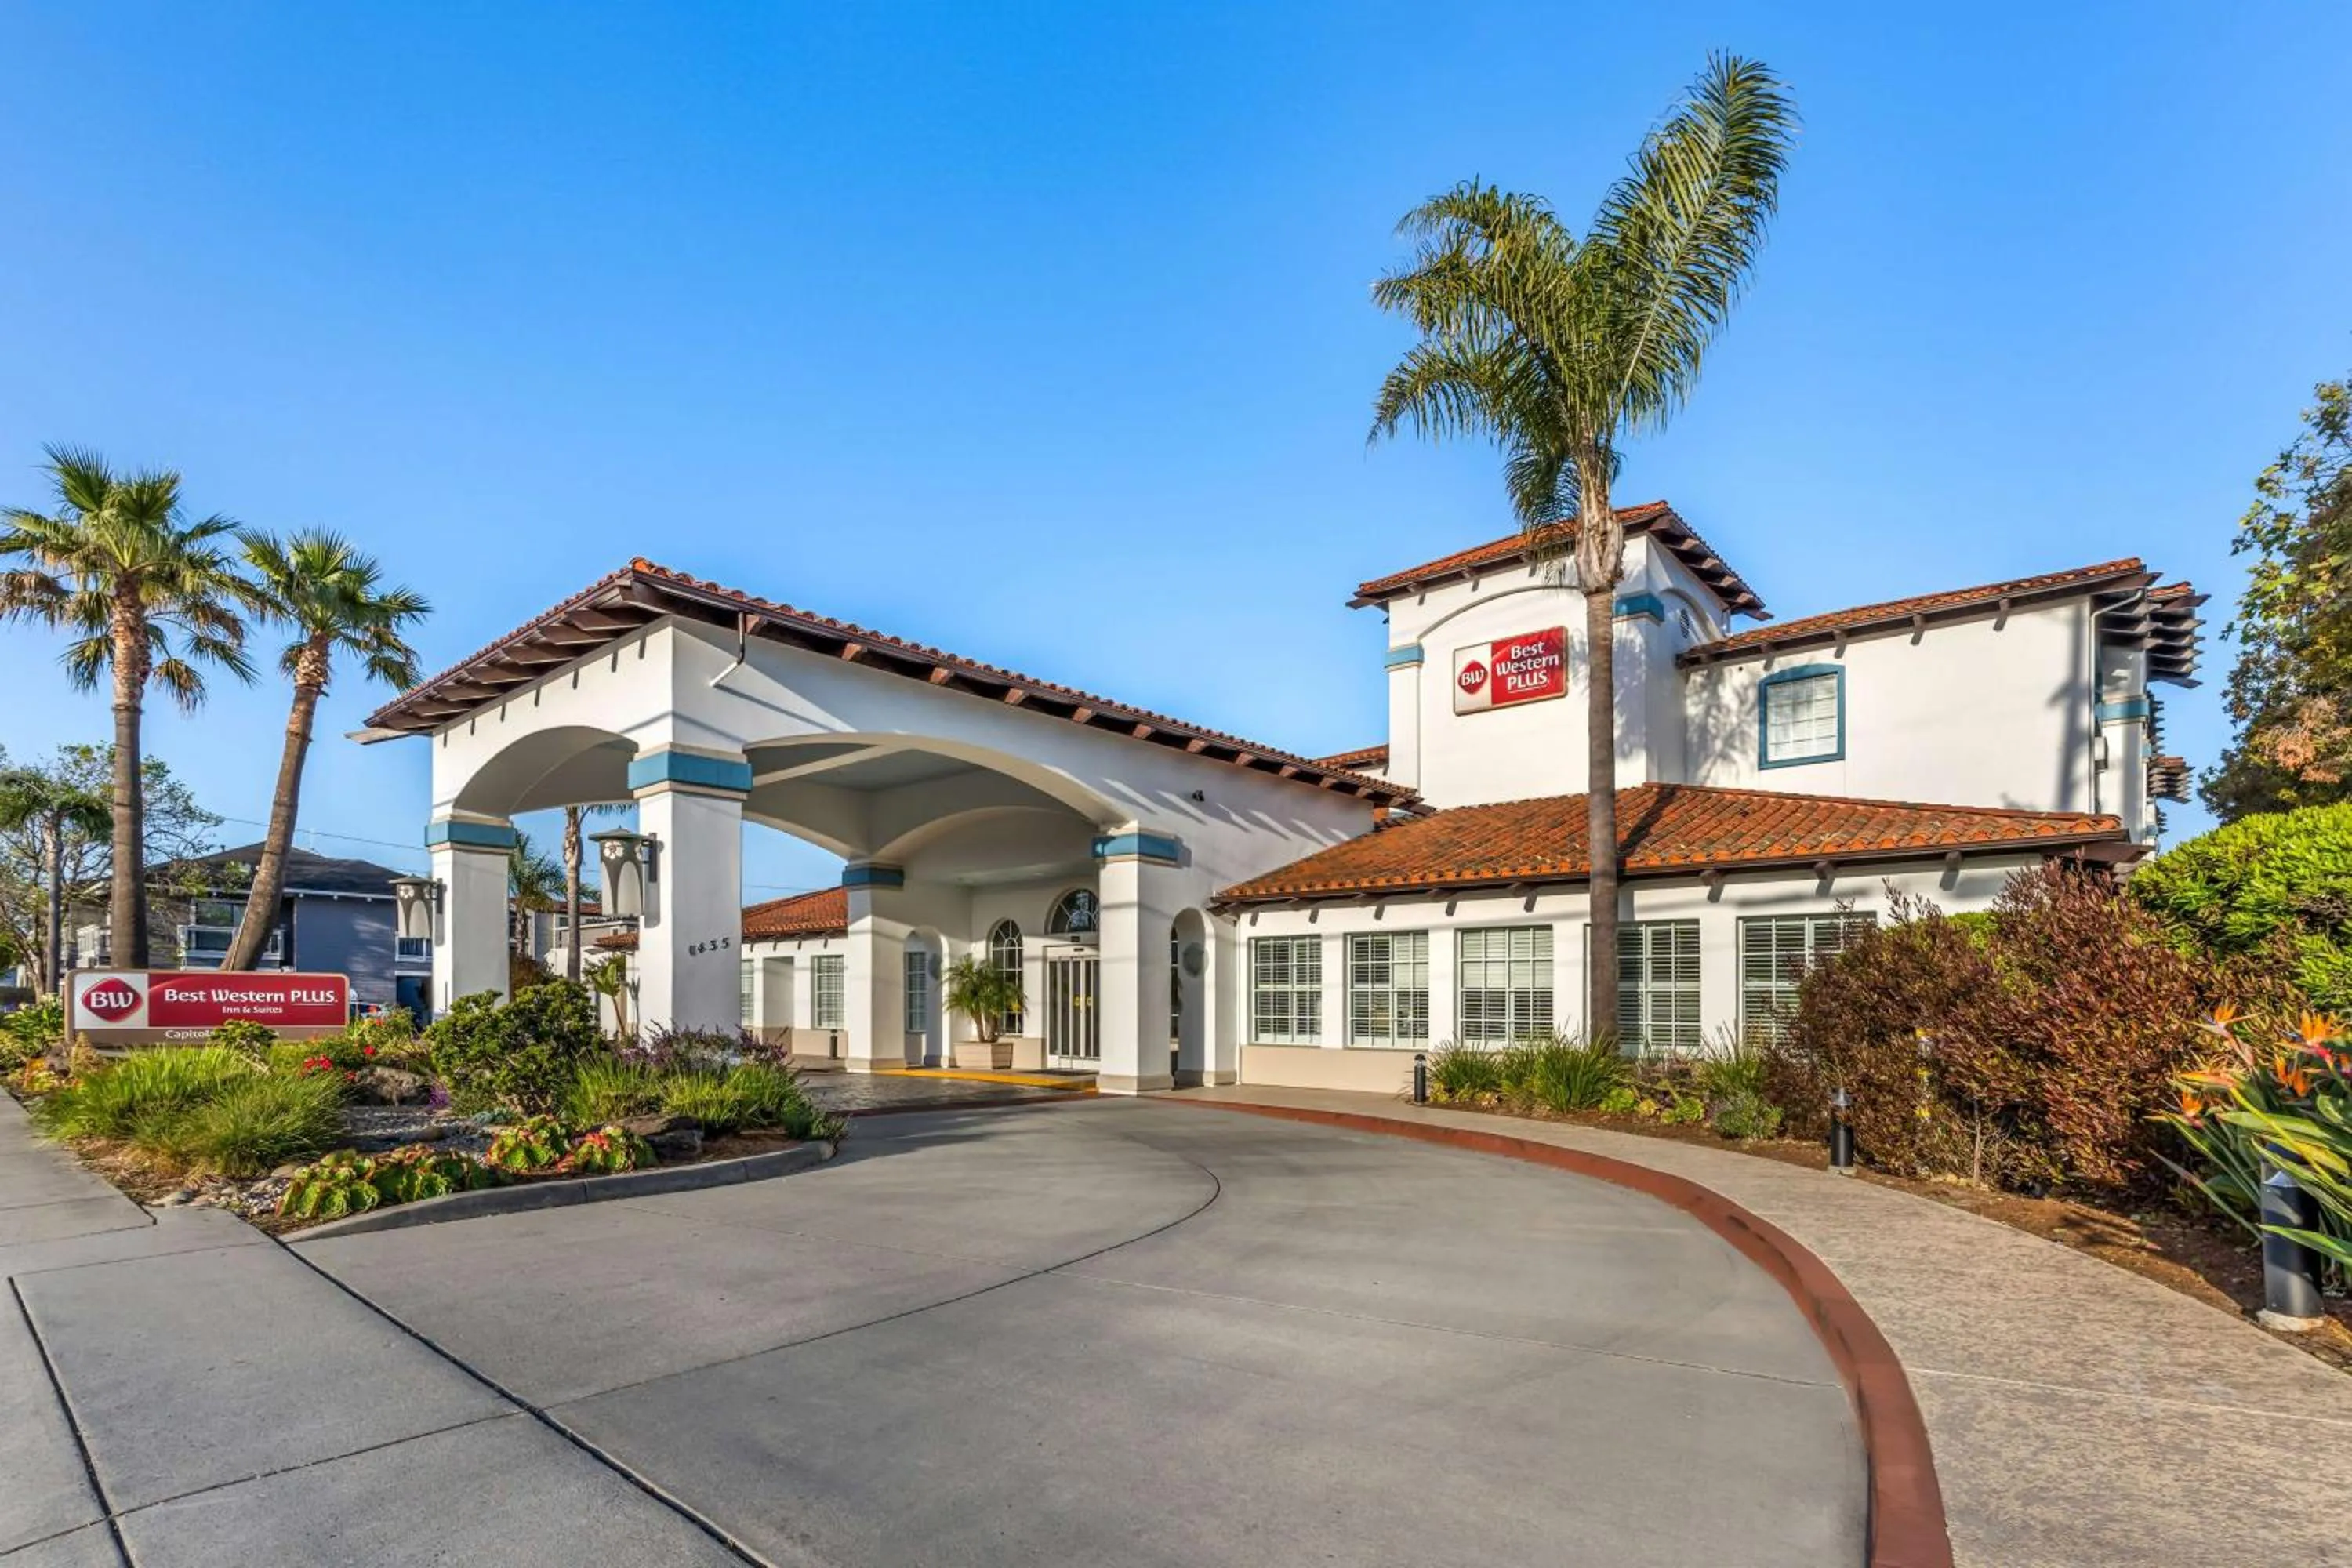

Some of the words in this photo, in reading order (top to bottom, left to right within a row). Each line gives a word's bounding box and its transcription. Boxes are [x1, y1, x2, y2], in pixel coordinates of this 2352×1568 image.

[1511, 641, 1544, 659] Best
[1496, 654, 1559, 677] Western
[1461, 669, 1484, 686] BW
[1507, 670, 1548, 691] PLUS
[90, 991, 134, 1009] BW
[164, 989, 207, 1003] Best
[210, 989, 285, 1003] Western
